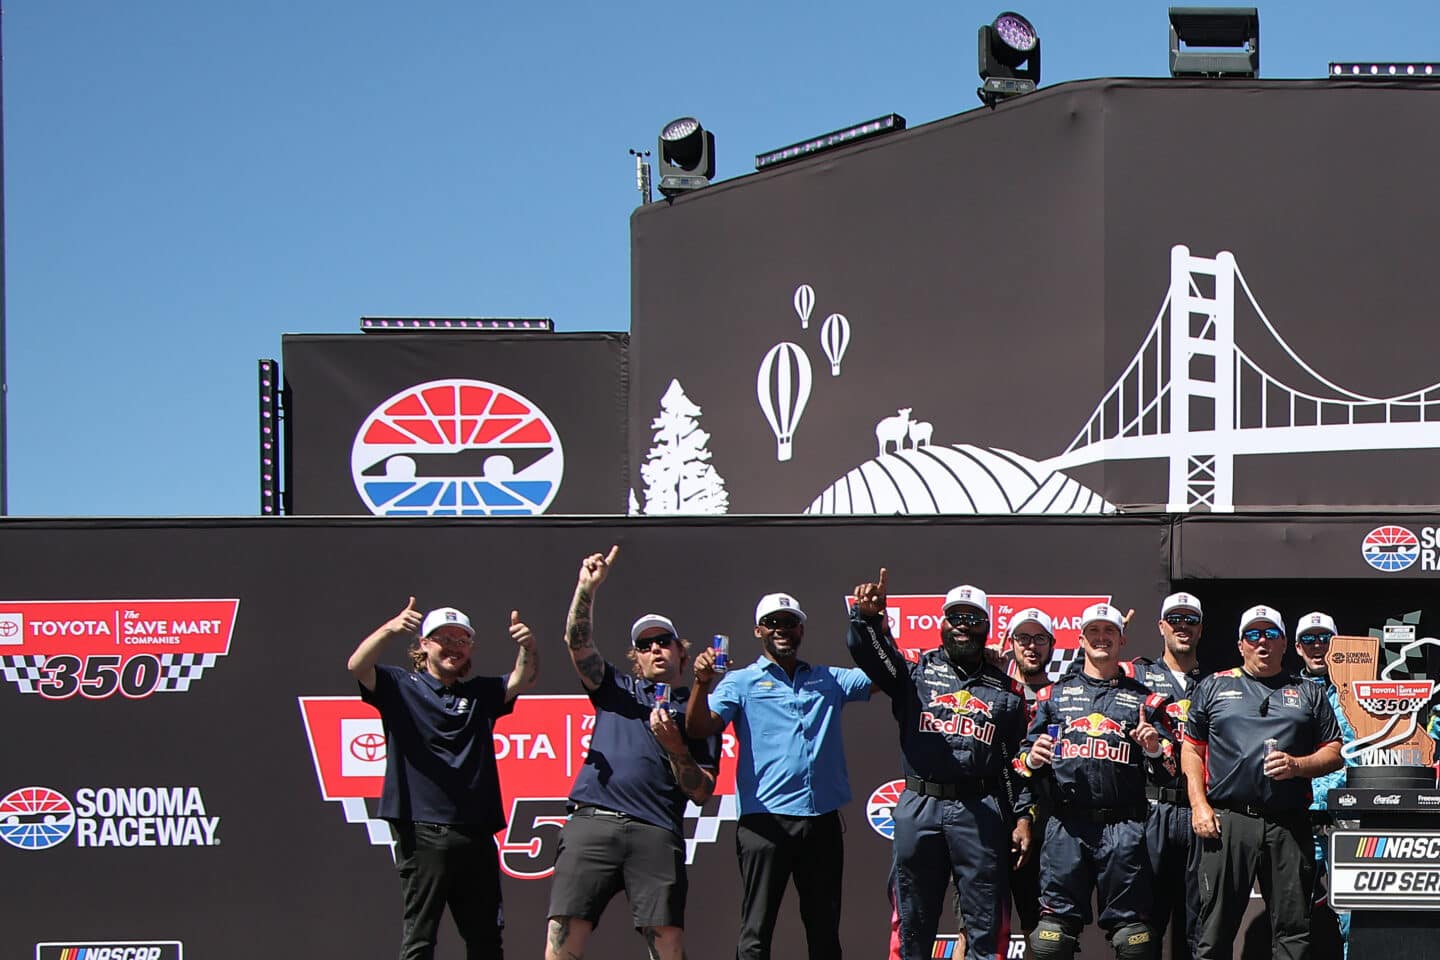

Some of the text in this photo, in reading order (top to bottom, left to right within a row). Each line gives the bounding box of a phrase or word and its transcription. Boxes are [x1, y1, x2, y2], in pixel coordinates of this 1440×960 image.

[124, 610, 140, 619] The
[998, 605, 1013, 614] The
[30, 620, 110, 636] TOYOTA
[124, 620, 222, 635] SAVE MART
[907, 615, 945, 630] TOY
[124, 636, 180, 645] COMPANIES
[38, 653, 162, 700] 350
[1375, 700, 1410, 711] 350
[919, 711, 995, 746] Red Bull
[493, 734, 556, 760] OTA
[1061, 738, 1130, 764] Red Bull
[1361, 748, 1423, 766] WINNER
[76, 787, 206, 817] SONOMA
[77, 817, 220, 847] RACEWAY
[1354, 872, 1397, 891] CUP
